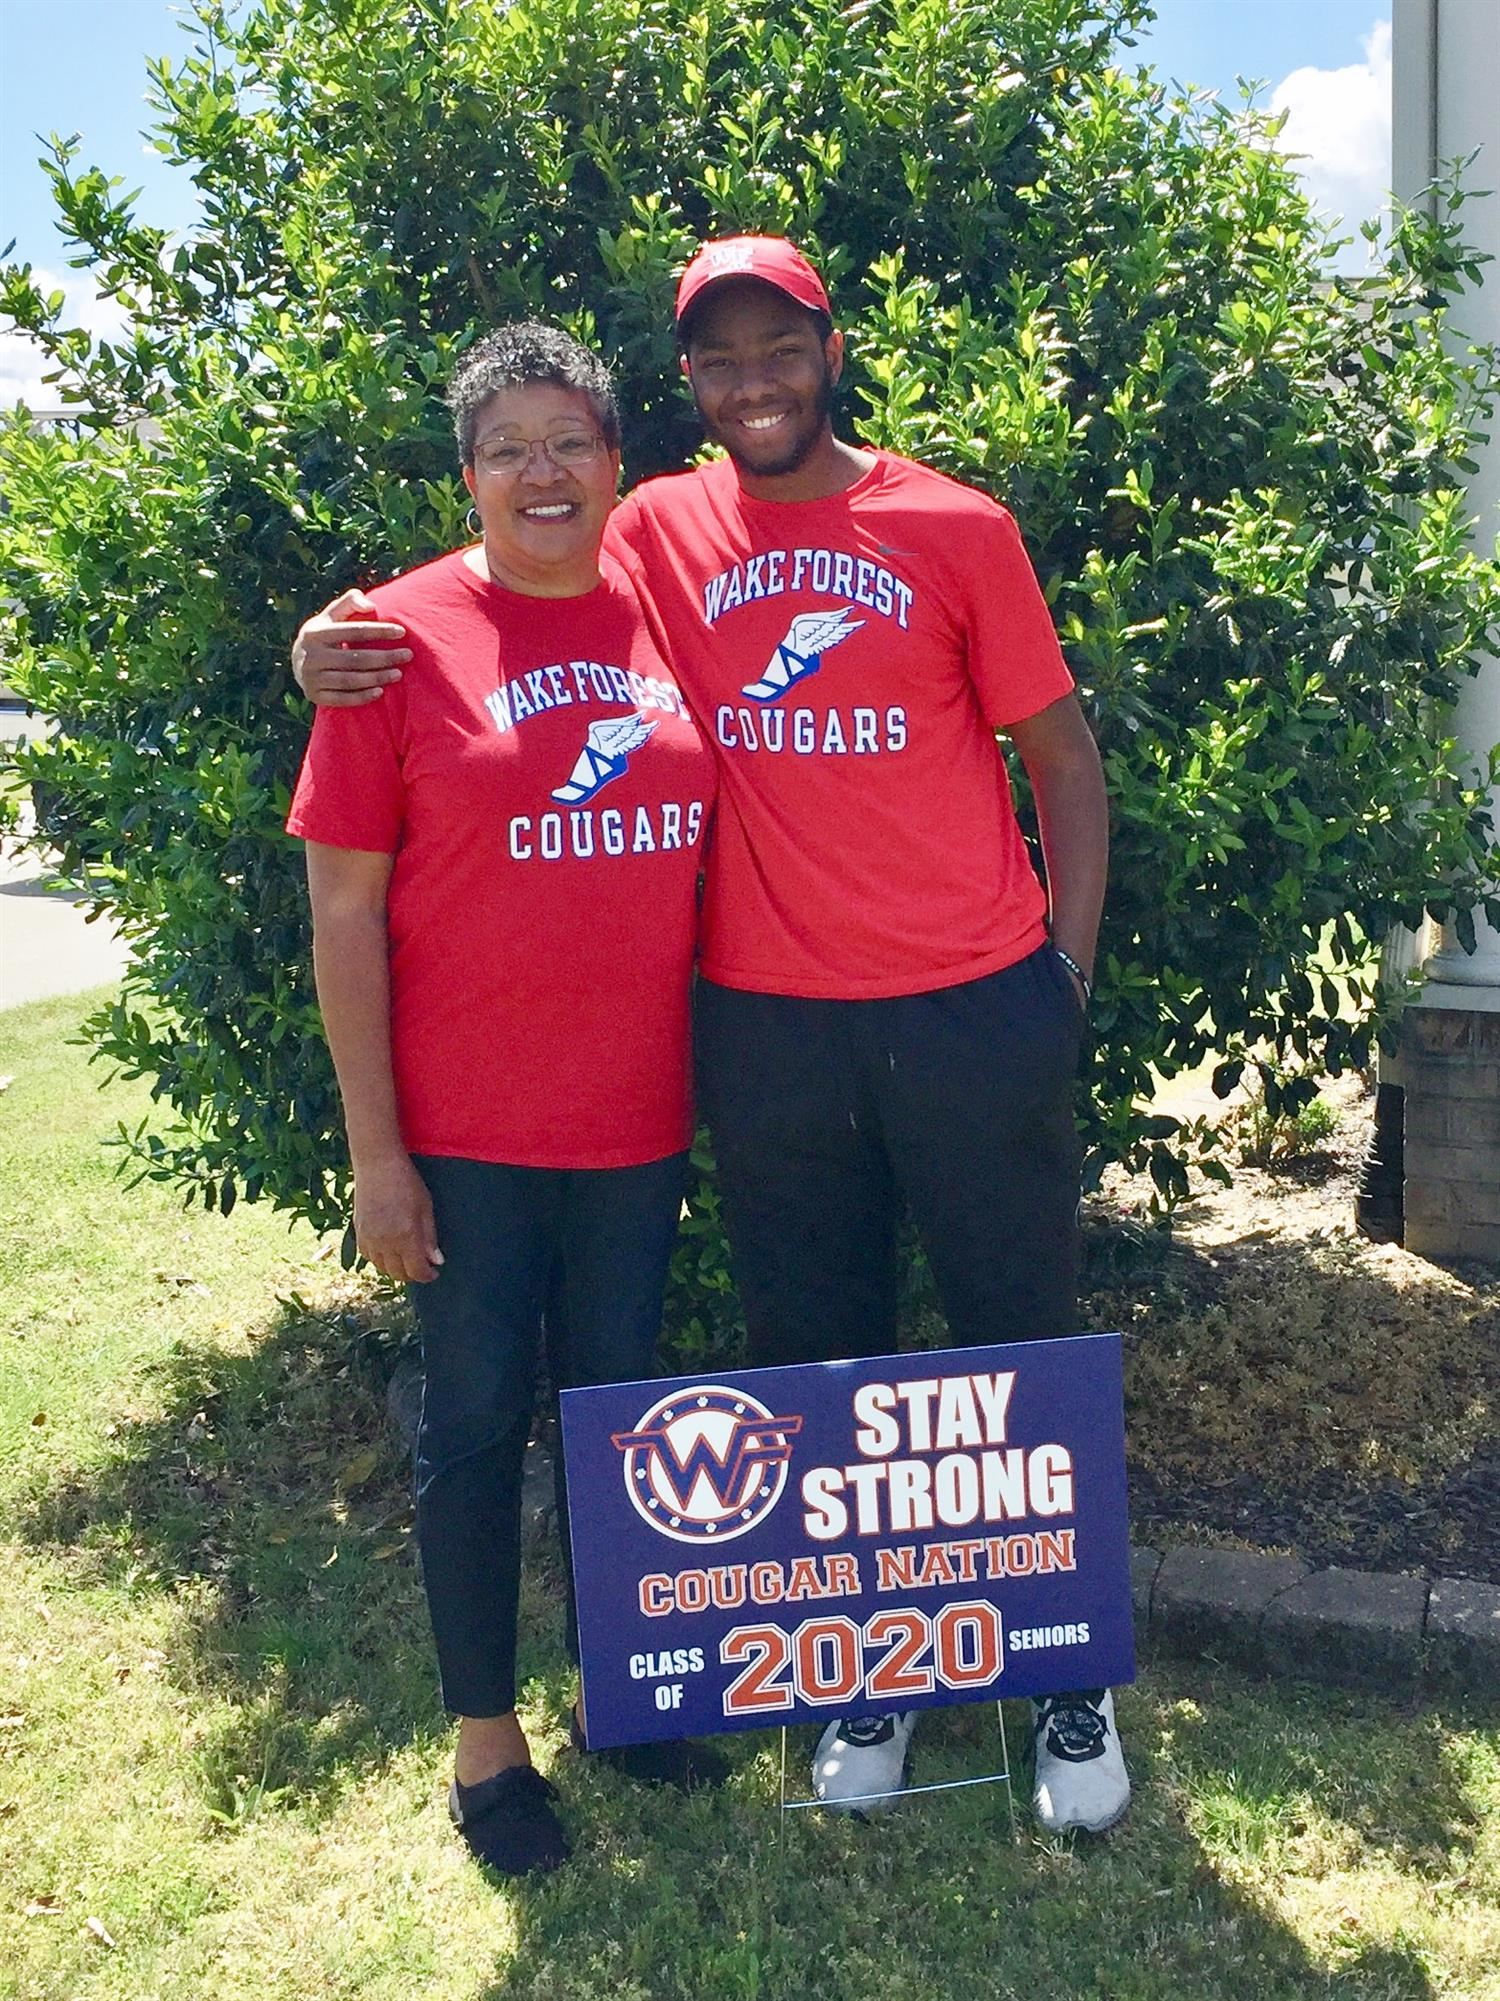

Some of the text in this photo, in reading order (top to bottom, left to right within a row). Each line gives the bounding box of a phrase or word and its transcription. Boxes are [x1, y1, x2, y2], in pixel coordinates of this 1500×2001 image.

[704, 548, 913, 631] WAKE FOREST
[484, 664, 573, 733] WAKE
[717, 705, 908, 755] COUGARS
[508, 800, 704, 861] COUGARS
[853, 1370, 1018, 1457] STAY
[801, 1442, 1076, 1542] STRONG
[638, 1528, 1077, 1618] COUGAR NATION
[629, 1647, 705, 1680] CLASS
[719, 1599, 1005, 1717] 2020
[1008, 1622, 1091, 1652] SENIORS
[655, 1684, 684, 1711] OF
